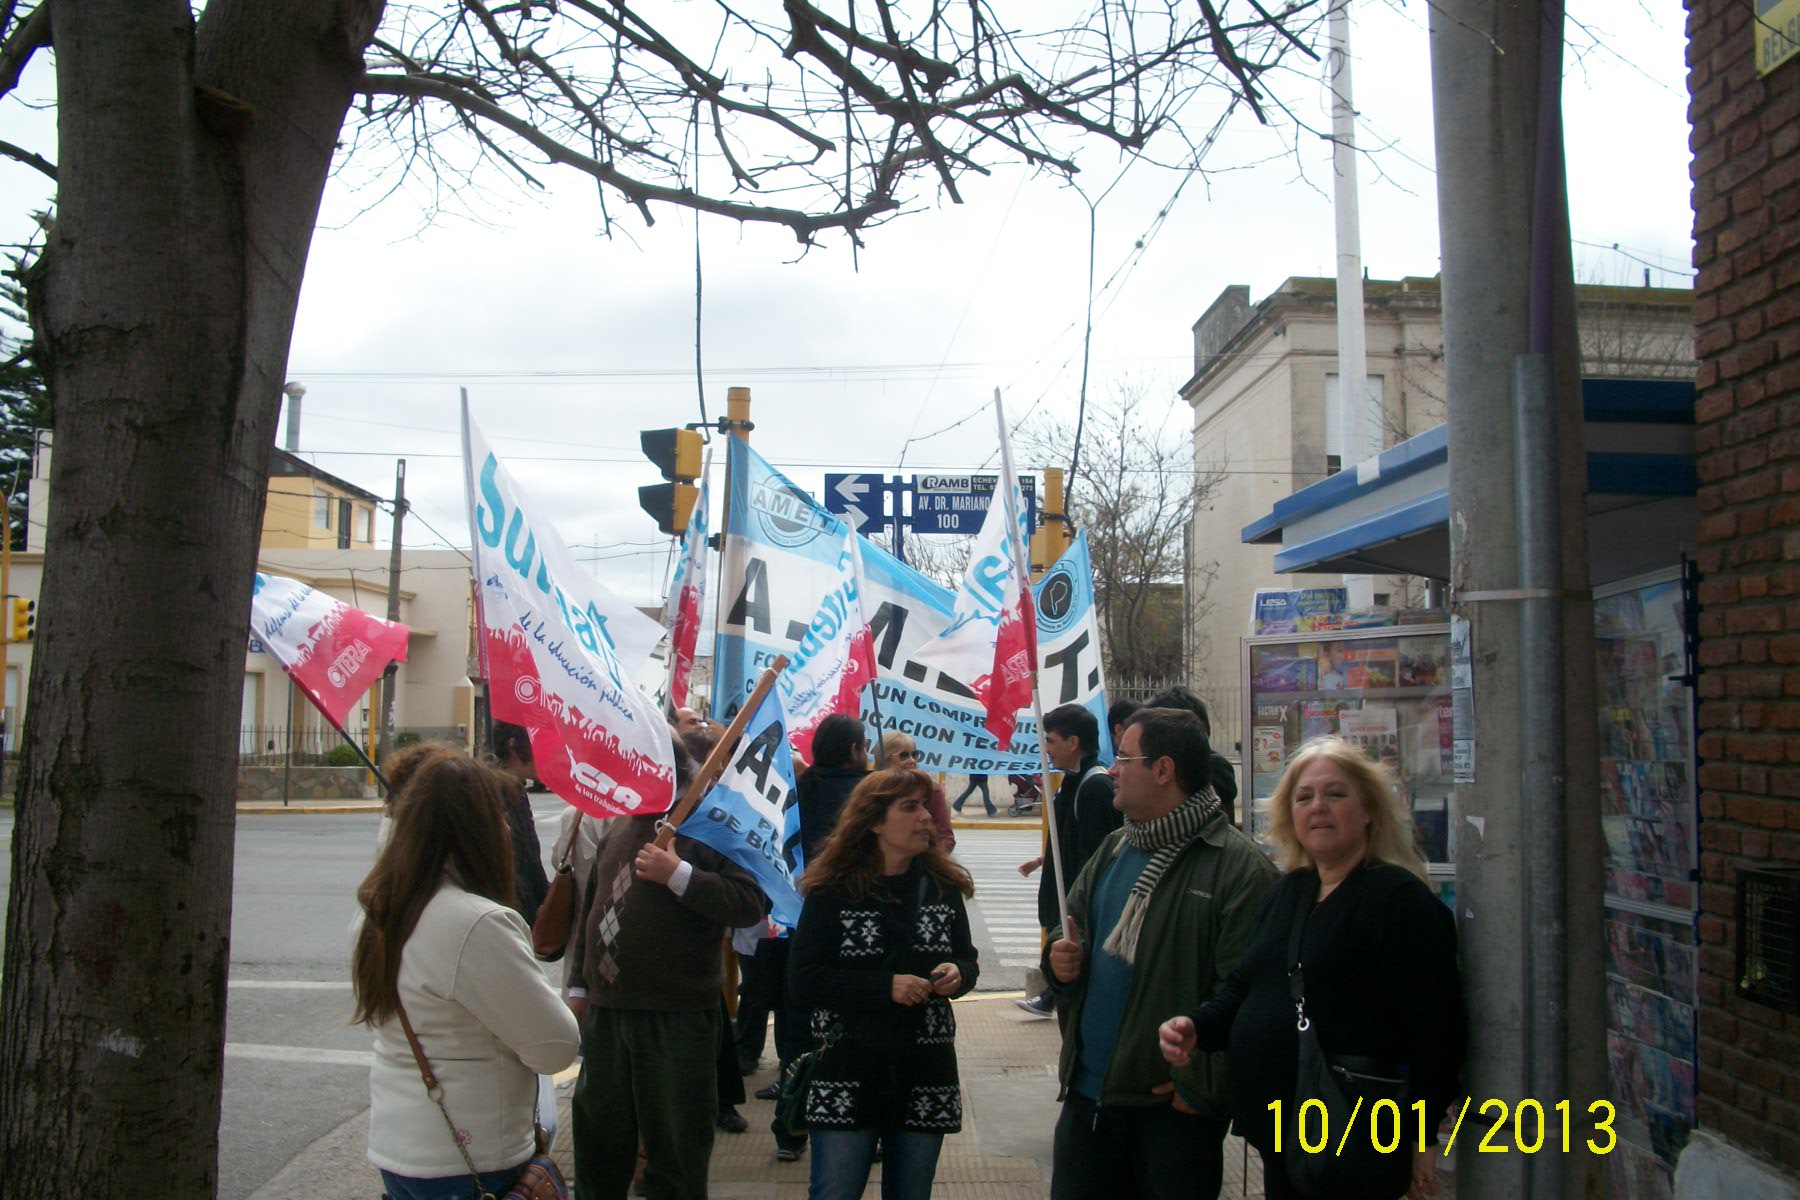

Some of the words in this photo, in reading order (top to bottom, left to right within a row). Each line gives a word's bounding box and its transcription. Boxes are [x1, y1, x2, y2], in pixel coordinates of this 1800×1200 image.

[922, 475, 969, 489] RAMB
[753, 488, 835, 529] AMET
[918, 496, 932, 511] AV.
[935, 496, 950, 511] DR.
[952, 496, 991, 511] MARIANO
[937, 514, 959, 529] 100
[327, 638, 371, 688] CTERA
[963, 732, 1041, 755] TECNIC
[948, 755, 1043, 771] PROFESI
[707, 806, 742, 834] DE
